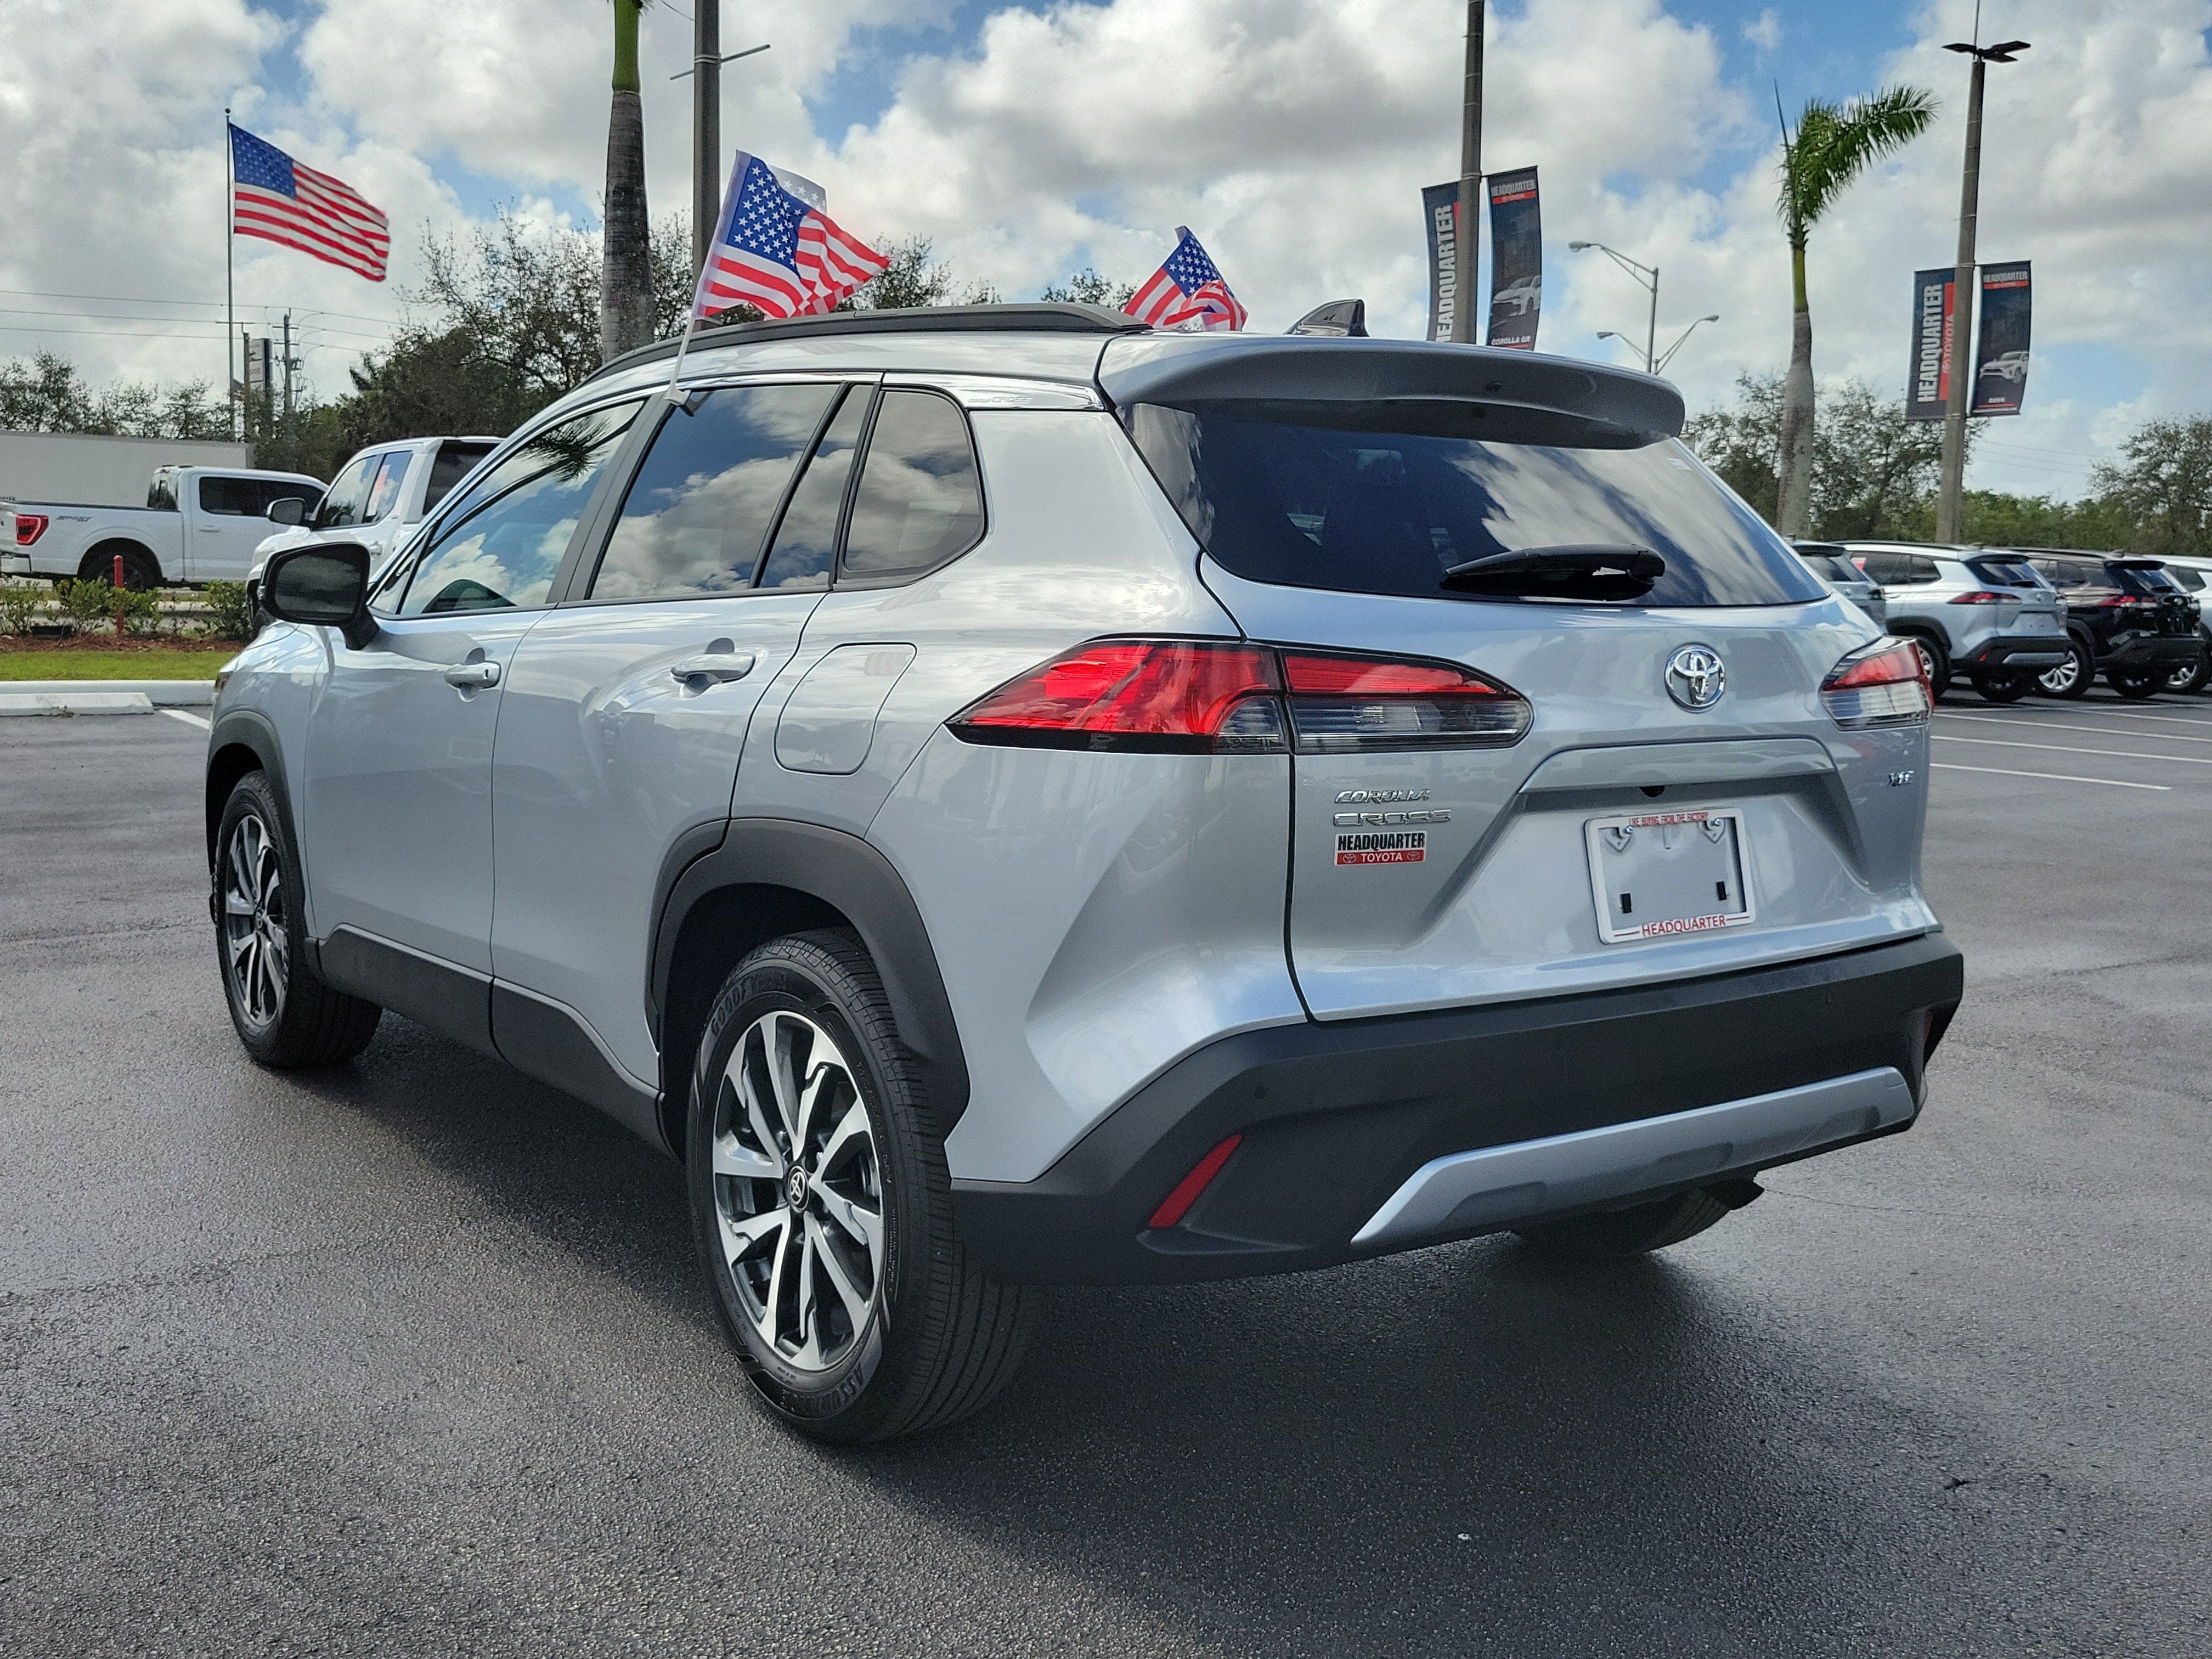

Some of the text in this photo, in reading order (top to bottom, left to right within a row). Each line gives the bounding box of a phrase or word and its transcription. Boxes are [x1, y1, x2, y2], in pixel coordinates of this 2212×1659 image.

[1917, 284, 1943, 402] HEADQUARTER
[1334, 788, 1431, 804] COROLLA
[1333, 809, 1452, 827] CROSS
[1338, 832, 1425, 851] HEADQUARTER
[1361, 852, 1403, 862] TOYOTA
[1642, 915, 1726, 937] HEADQUARTER
